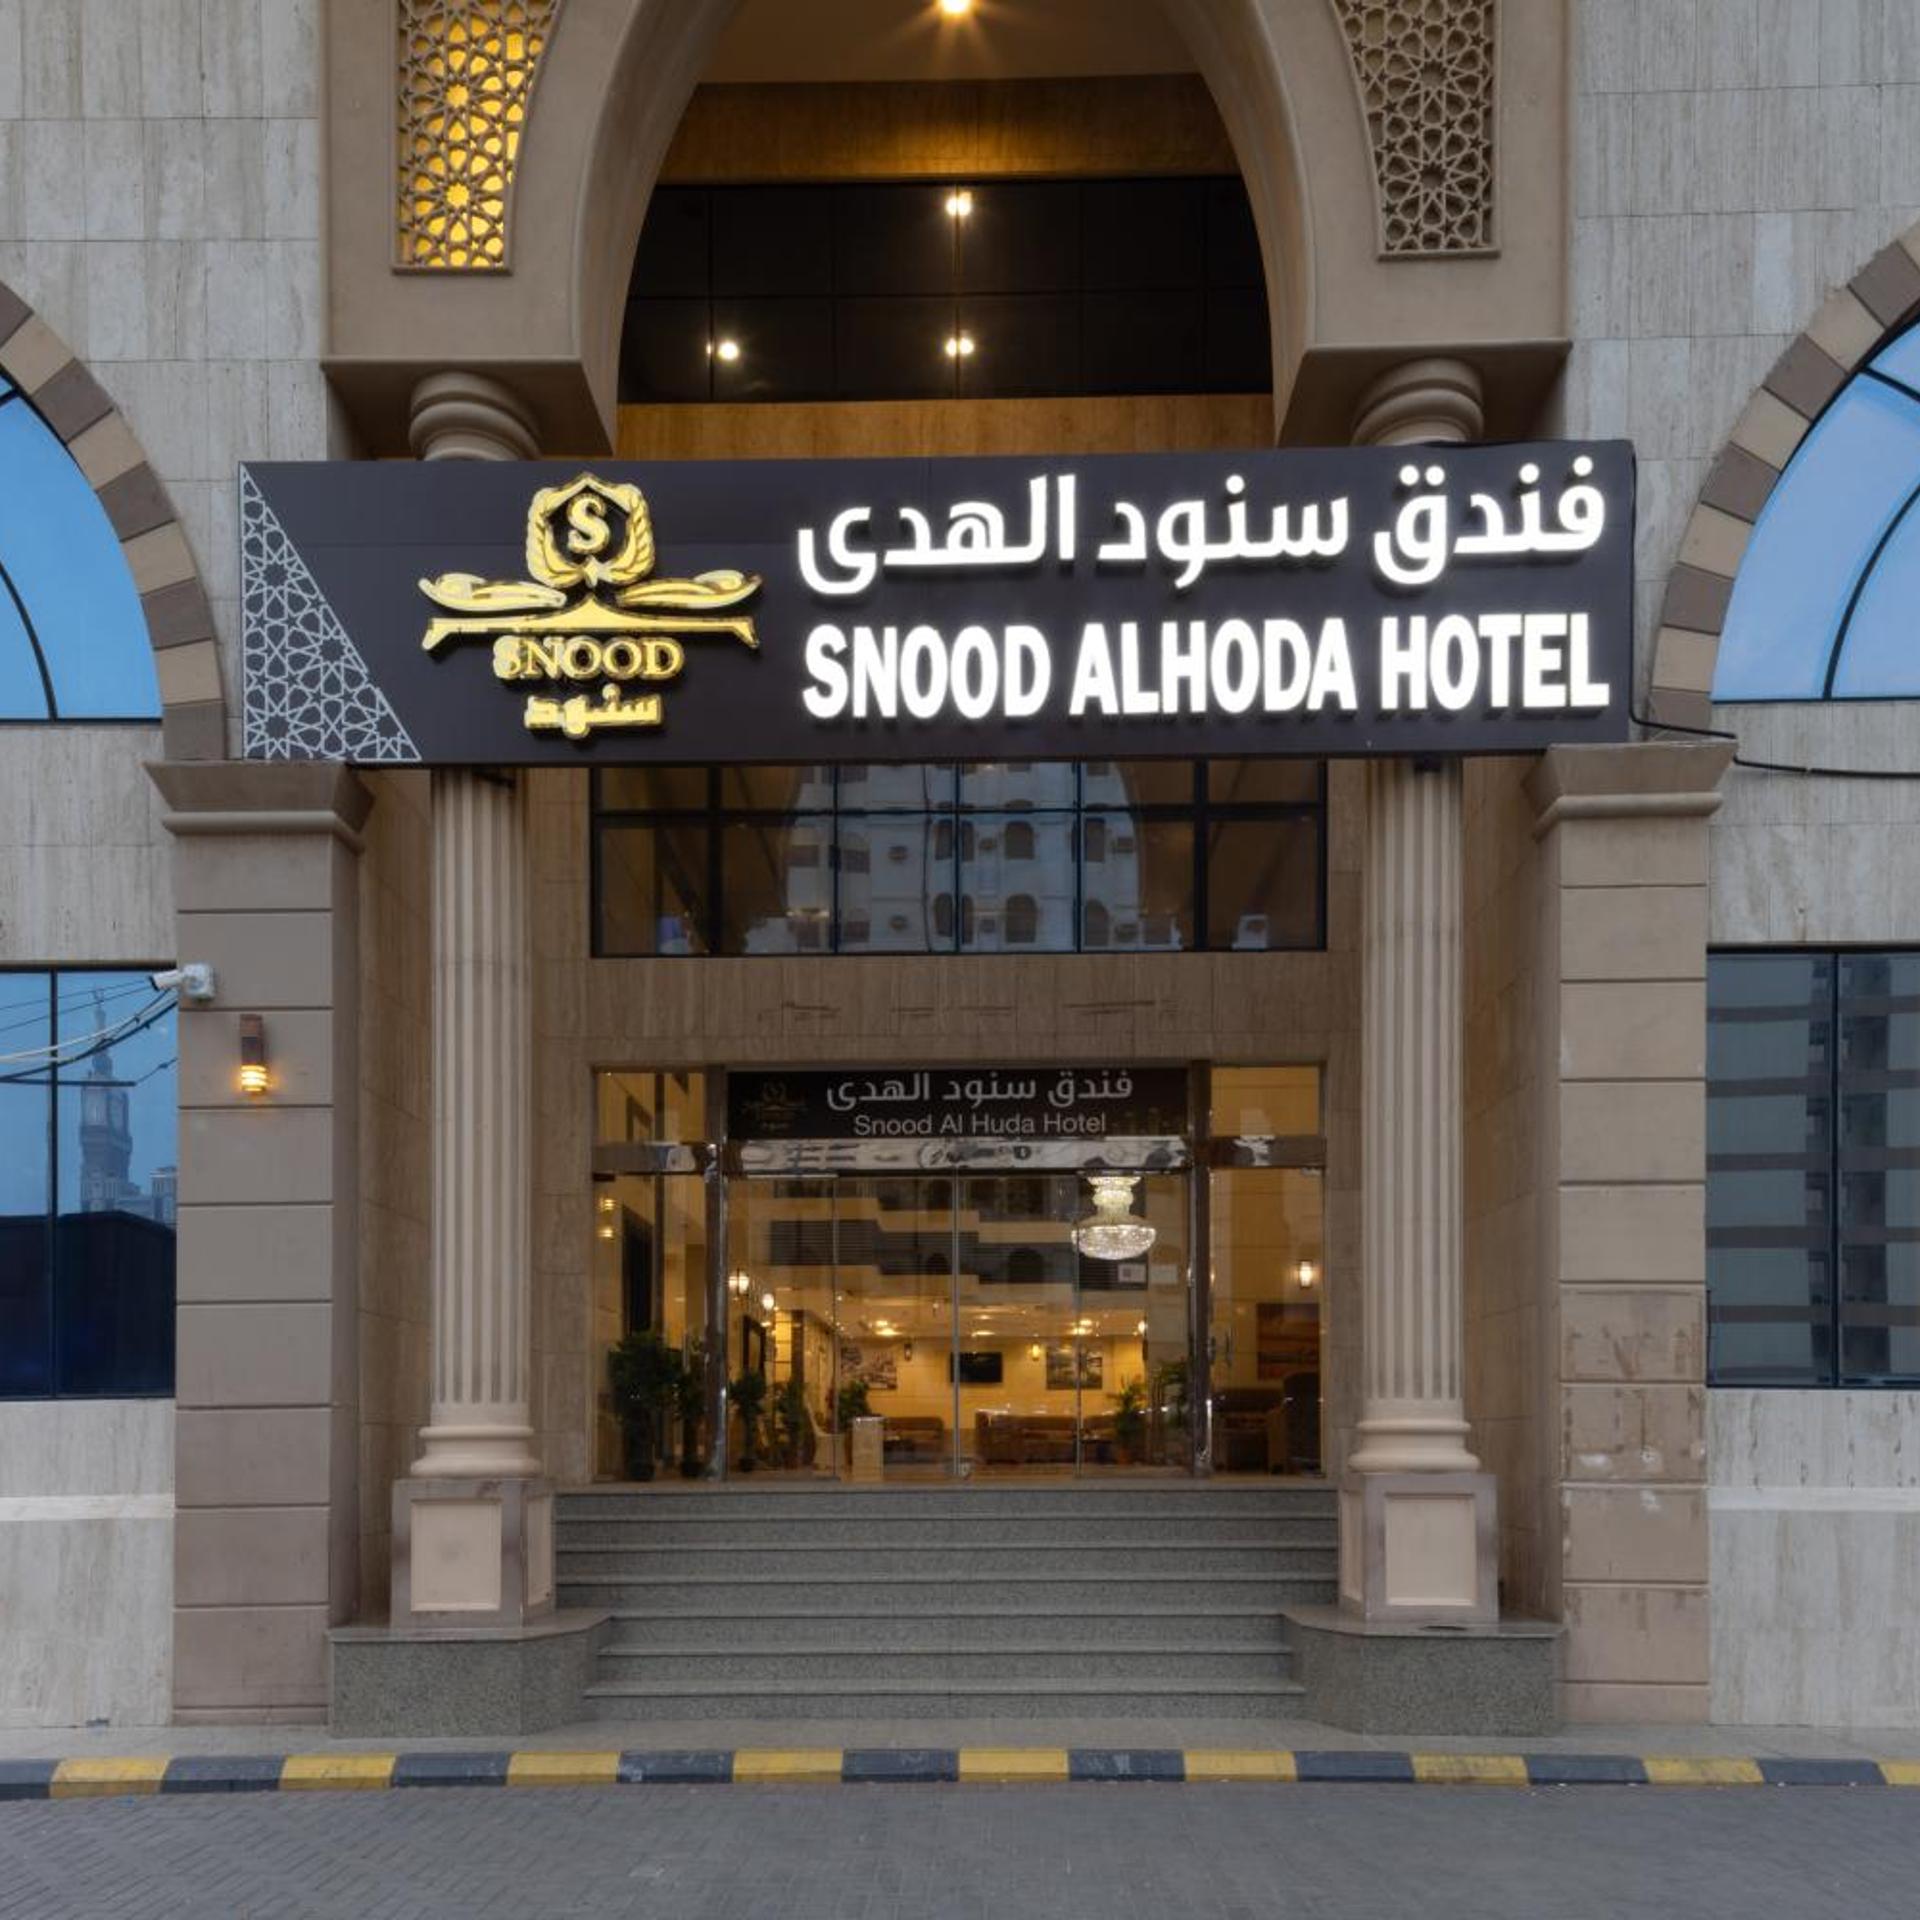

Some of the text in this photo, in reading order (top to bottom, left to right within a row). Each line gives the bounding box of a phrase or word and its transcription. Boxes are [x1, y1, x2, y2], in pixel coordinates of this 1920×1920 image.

[798, 456, 1605, 595] فندق سنود الهدى
[493, 635, 685, 680] SNOOD
[802, 612, 1610, 719] SNOOD ALHODA HOTEL
[524, 683, 662, 739] سنود
[826, 1071, 1134, 1111] فندق سنود الهدى
[854, 1113, 1107, 1136] Snood Al Huda Hotel
